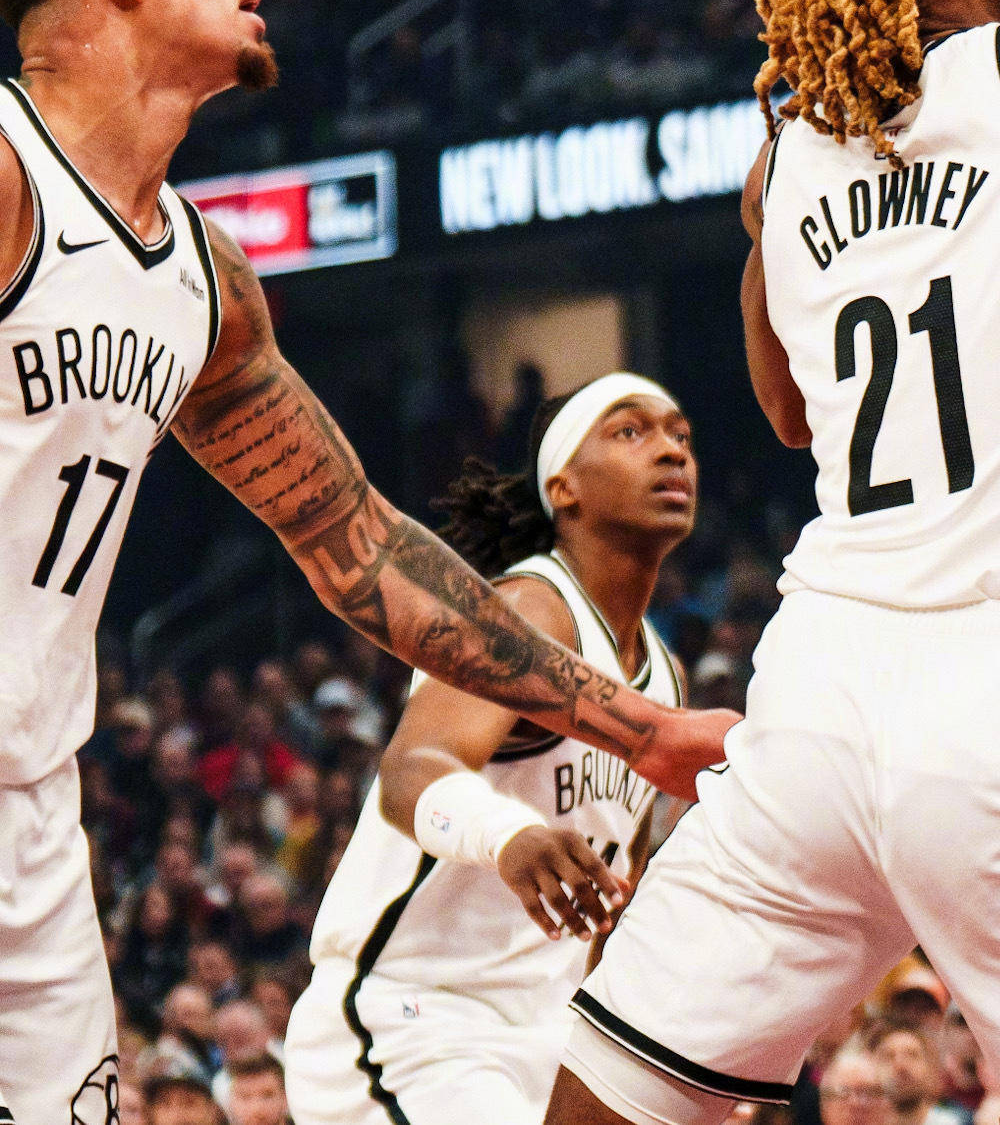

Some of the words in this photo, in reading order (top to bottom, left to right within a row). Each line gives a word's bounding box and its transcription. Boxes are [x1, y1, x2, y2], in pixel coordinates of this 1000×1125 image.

[439, 137, 534, 235] NEW
[658, 97, 775, 202] SAM
[799, 160, 989, 271] CLOWNEY
[12, 323, 189, 443] BROOKLY
[834, 275, 975, 517] 21
[31, 453, 129, 597] 17
[554, 748, 654, 819] BROOKLY
